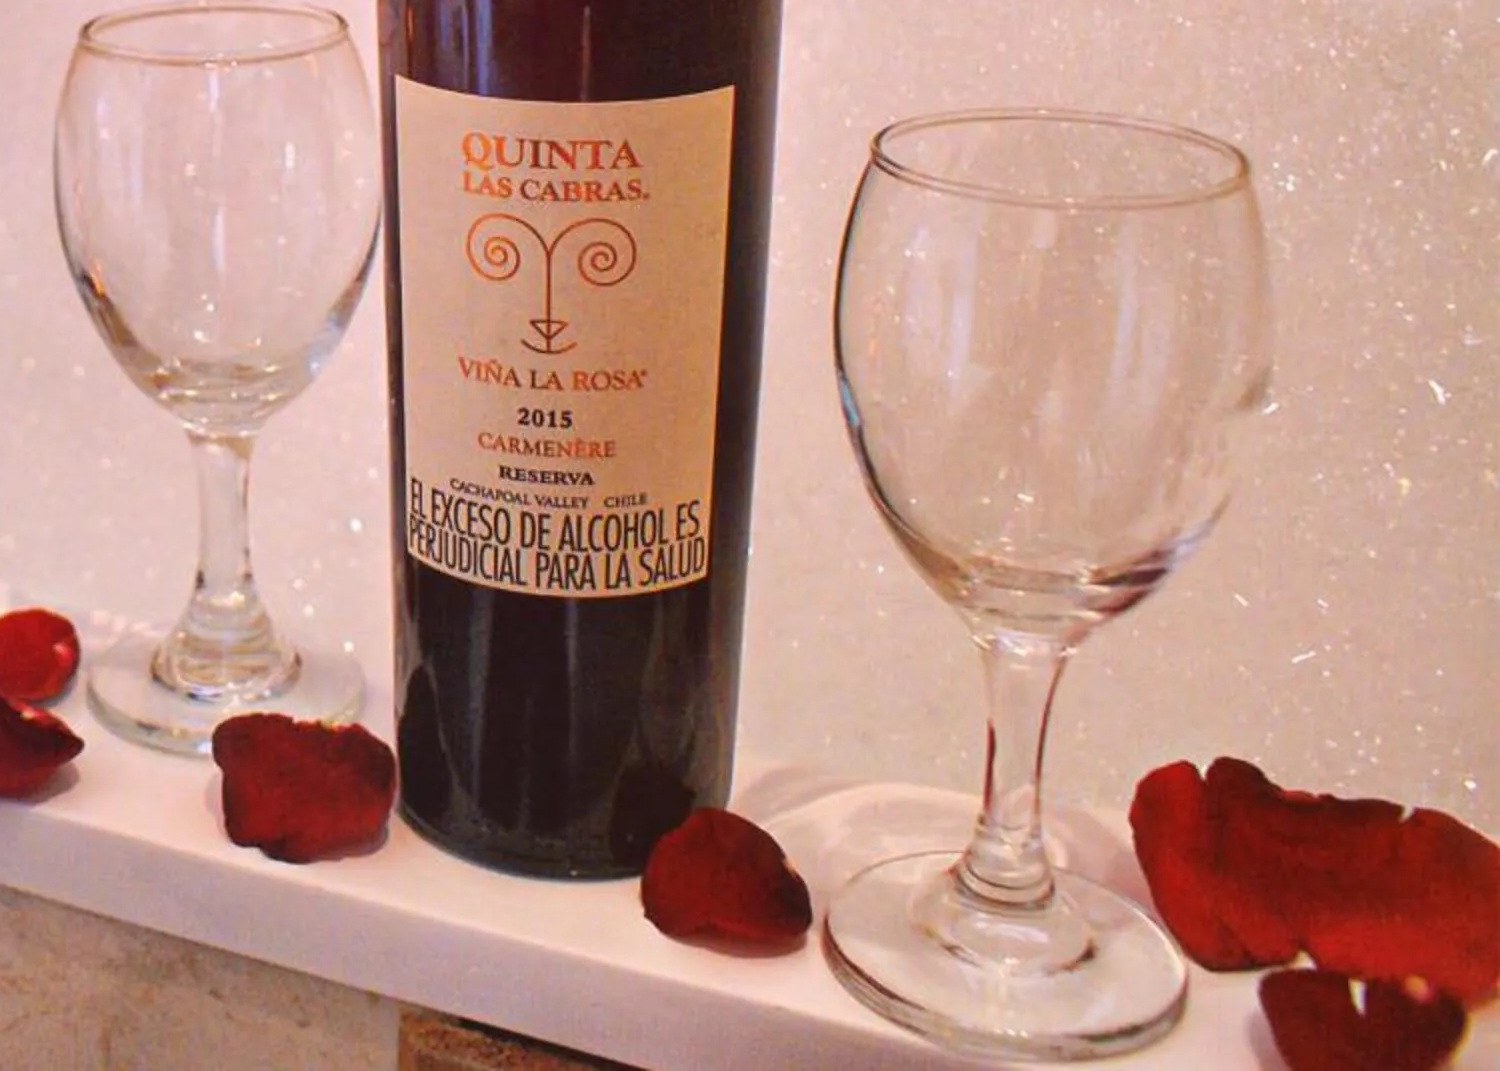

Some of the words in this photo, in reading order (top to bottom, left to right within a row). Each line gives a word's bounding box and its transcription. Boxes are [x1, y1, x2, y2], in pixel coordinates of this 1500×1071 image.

[461, 132, 643, 170] QUINTA
[462, 172, 512, 198] LAS
[457, 356, 522, 389] VIÑA
[529, 370, 564, 390] LA
[516, 407, 574, 429] 2015
[477, 432, 617, 459] CARMENÈRE
[499, 465, 595, 486] RESERVA
[534, 494, 590, 510] VALLEY
[603, 492, 648, 509] CHILE
[410, 477, 425, 519] EL
[431, 488, 512, 546] EXCESO
[520, 512, 551, 551] DE
[558, 508, 668, 553] ALCOHOL
[675, 499, 701, 540] ES
[408, 517, 527, 587] PERJUDICIAL
[535, 550, 597, 590] PARA
[604, 551, 631, 590] LA
[638, 536, 706, 587] SALUD
